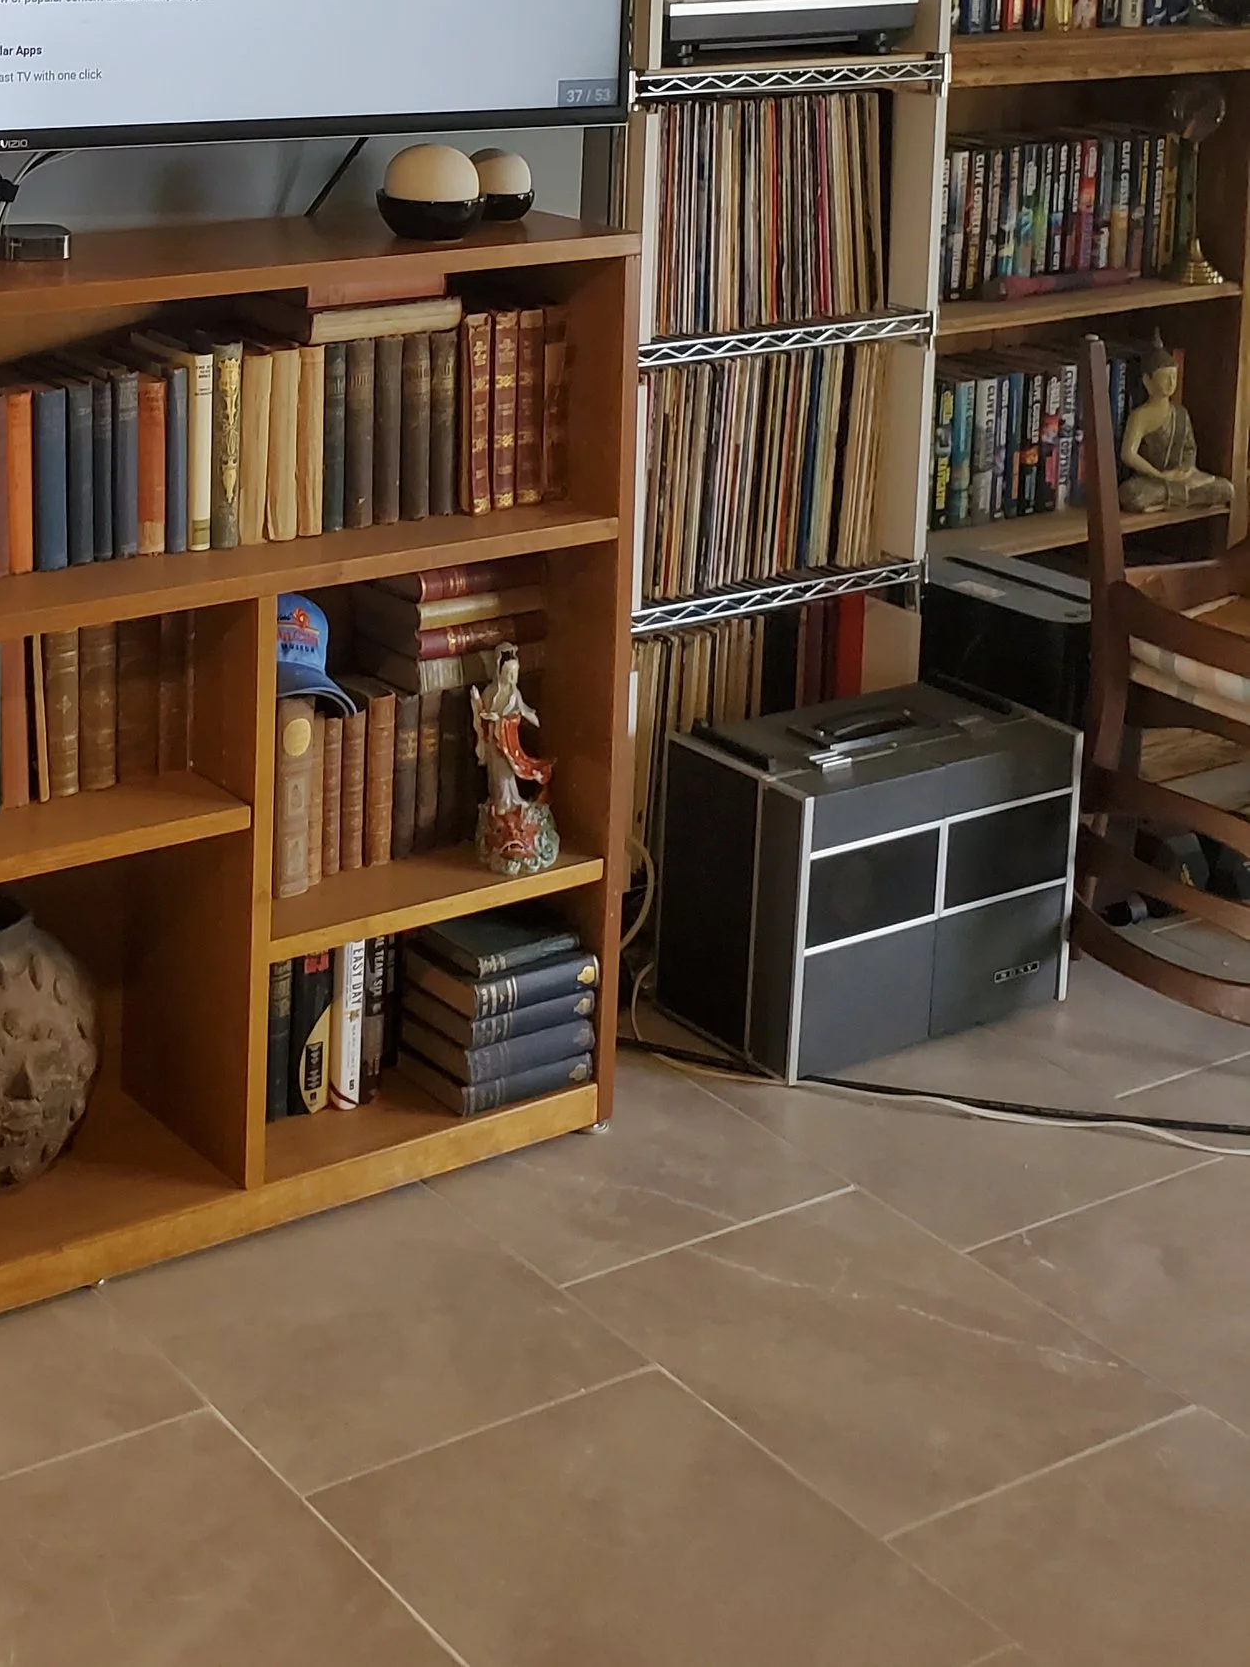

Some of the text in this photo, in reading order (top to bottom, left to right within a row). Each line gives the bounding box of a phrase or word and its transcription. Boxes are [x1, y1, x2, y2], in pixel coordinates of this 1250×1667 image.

[14, 44, 42, 58] Apps
[16, 70, 32, 82] TV
[32, 69, 55, 82] with
[56, 71, 77, 81] one
[78, 67, 102, 80] click
[566, 89, 583, 103] 37
[594, 88, 611, 102] 53
[0, 138, 28, 149] VIZIO
[1121, 141, 1131, 170] CLIVE
[975, 154, 985, 186] CLIVE
[986, 385, 995, 417] CLIVE
[352, 947, 364, 979] EASY
[351, 984, 363, 1006] DAY
